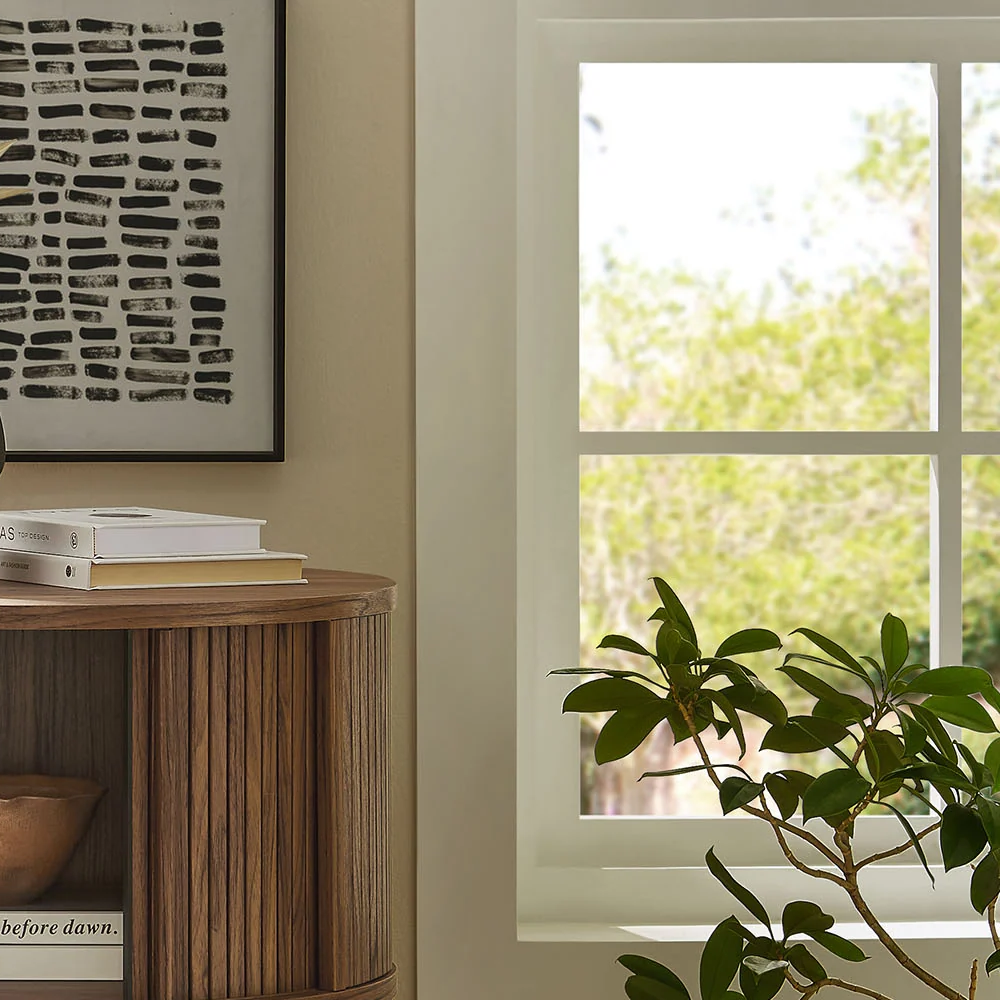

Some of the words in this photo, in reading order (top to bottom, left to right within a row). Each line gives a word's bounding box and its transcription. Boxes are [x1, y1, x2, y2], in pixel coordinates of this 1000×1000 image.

[29, 533, 50, 541] DESIGN
[0, 919, 58, 938] before
[62, 918, 119, 935] dawn.
